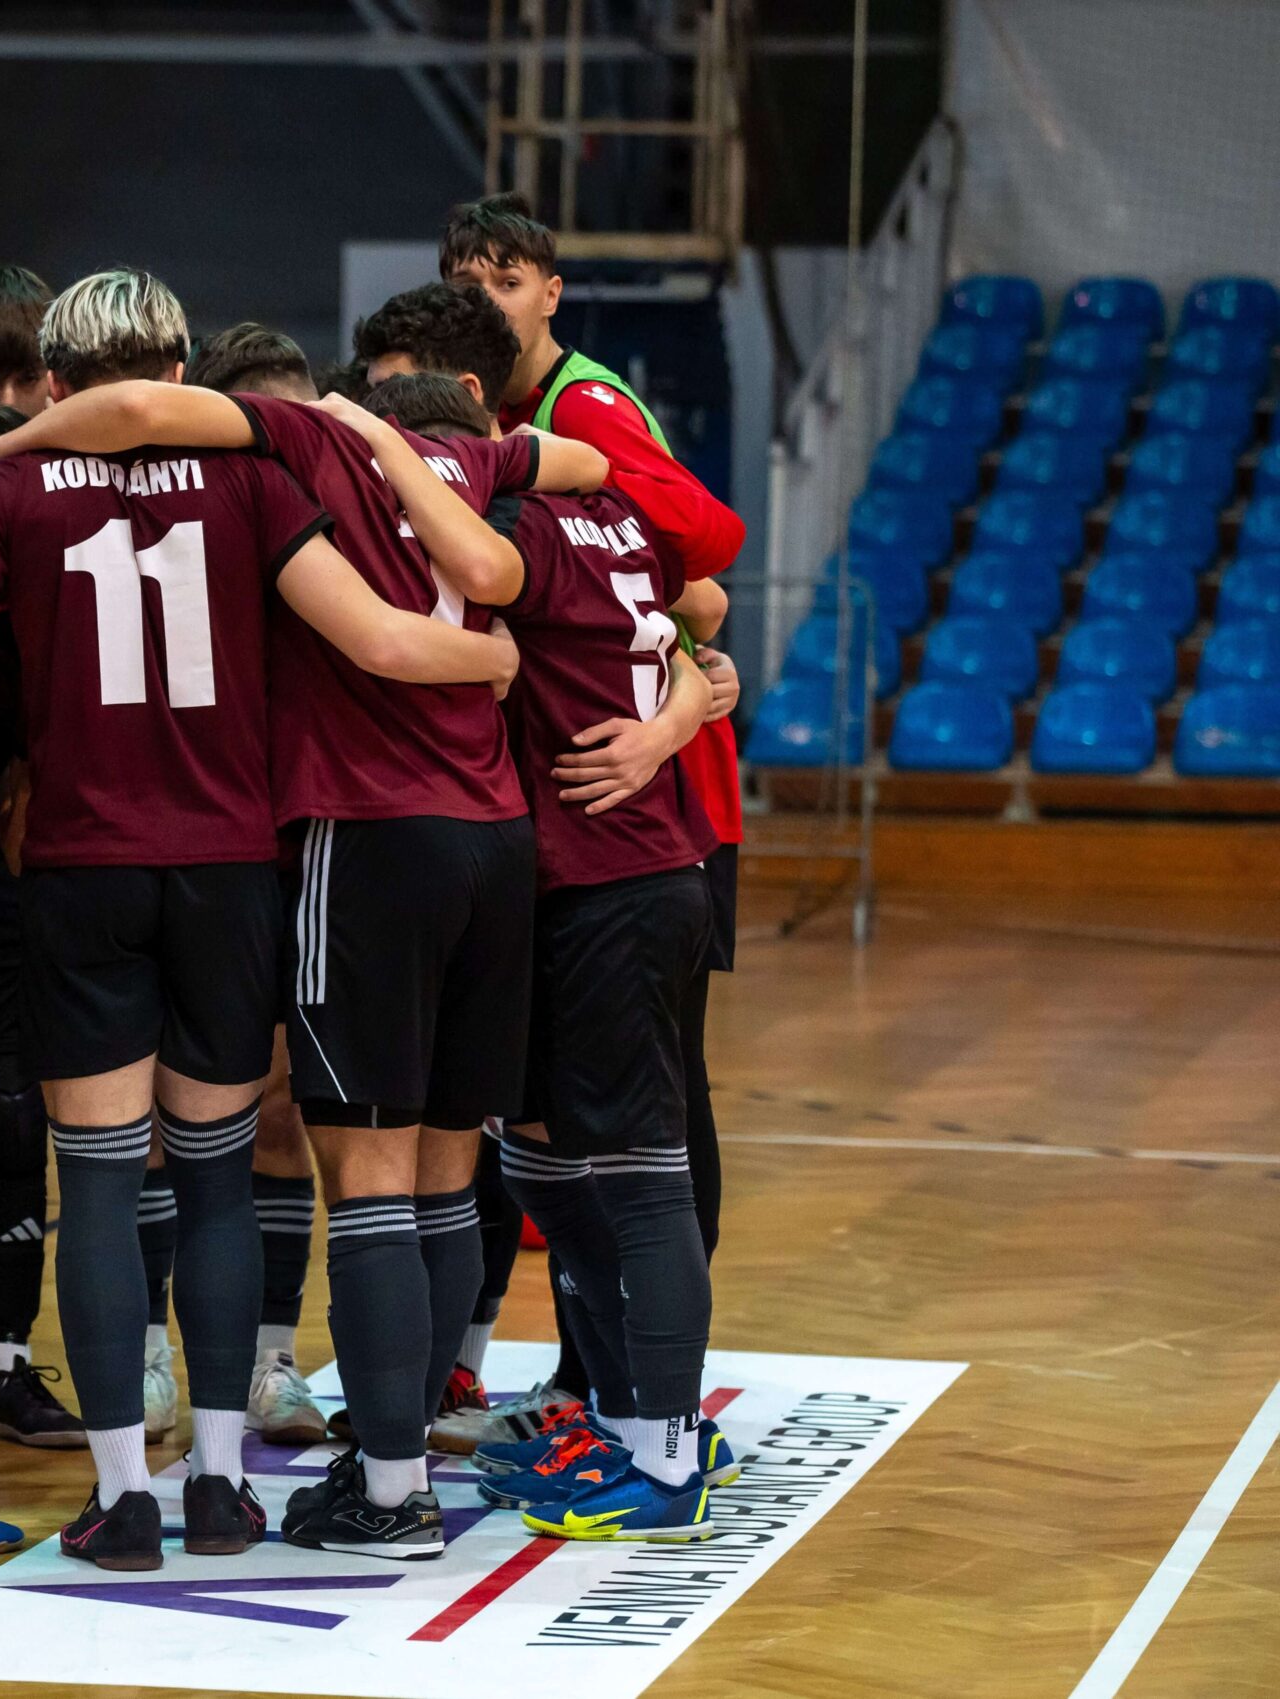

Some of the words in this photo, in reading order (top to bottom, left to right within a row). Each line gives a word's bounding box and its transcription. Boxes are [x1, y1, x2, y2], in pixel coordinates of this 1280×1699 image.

[64, 518, 216, 708] 11
[610, 572, 677, 723] 5
[757, 1392, 908, 1451] GROUP
[628, 1454, 854, 1564] INSURANCE
[525, 1570, 739, 1647] VIENNA
